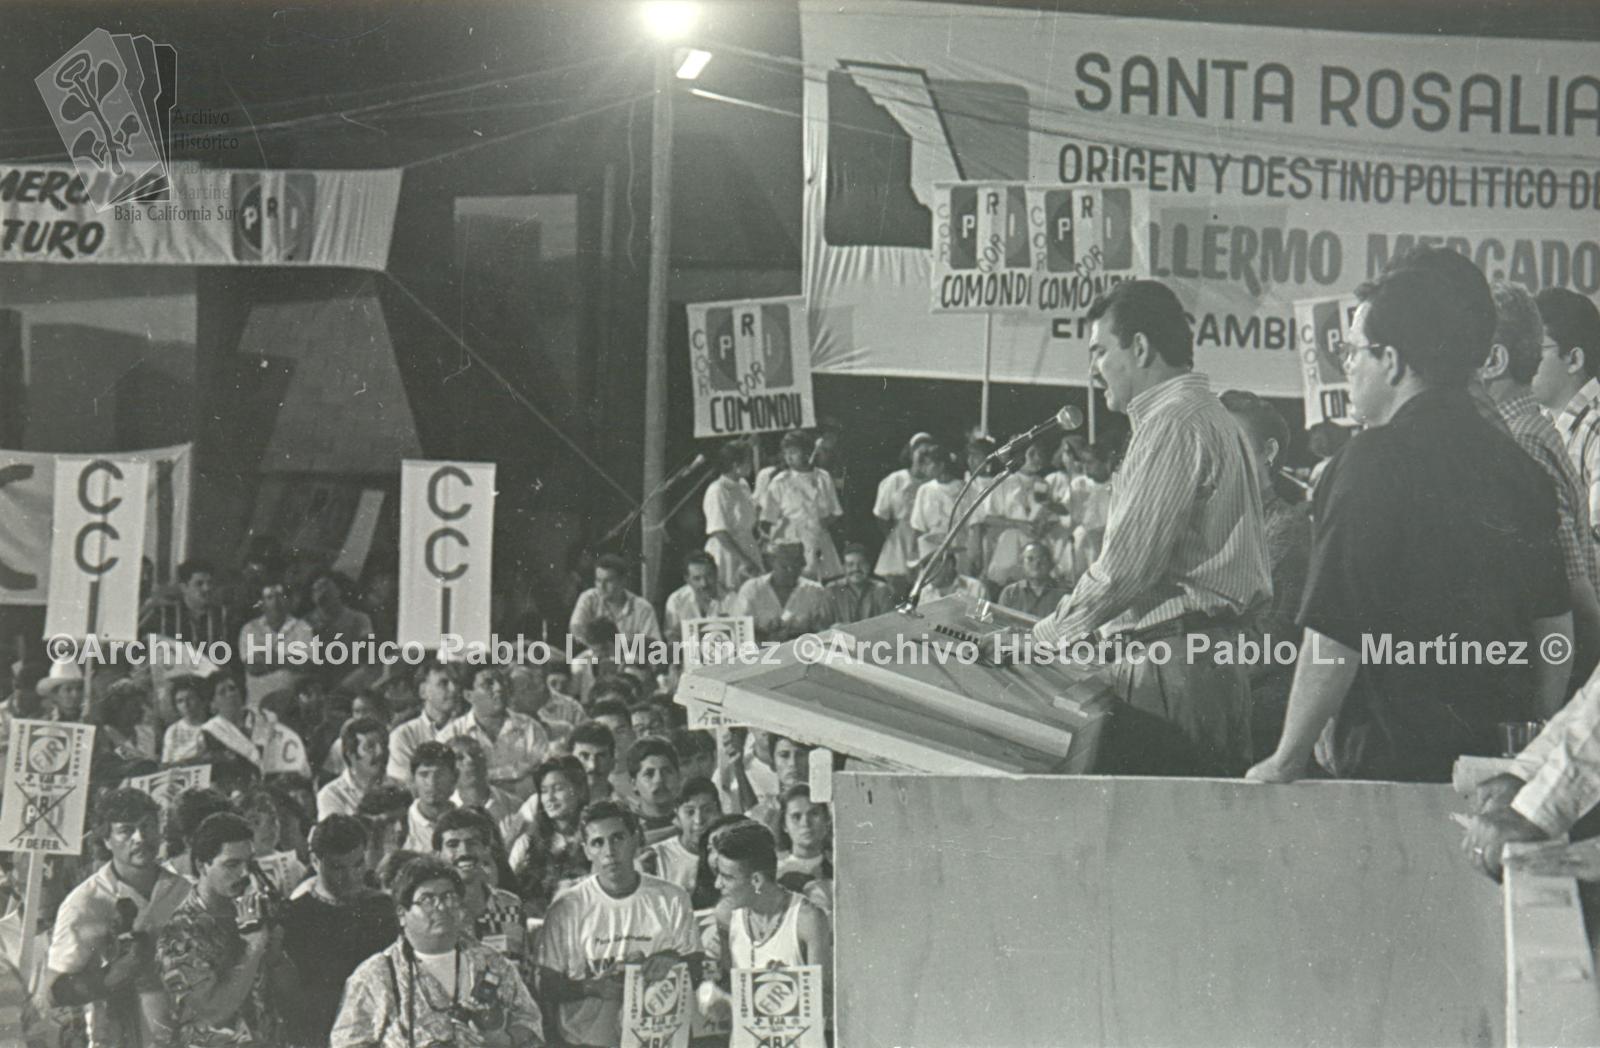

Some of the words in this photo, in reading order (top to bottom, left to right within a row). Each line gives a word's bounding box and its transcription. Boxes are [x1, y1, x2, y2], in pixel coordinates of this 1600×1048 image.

[1075, 53, 1294, 123] SANTA
[1320, 66, 1600, 136] ROSALIA
[1059, 143, 1196, 193] ORIGEN
[1209, 153, 1231, 194] Y
[1242, 155, 1395, 205] DESTINO
[1404, 164, 1557, 209] POLITICO
[1150, 222, 1342, 297] LLERMO
[1184, 312, 1297, 350] AMBI
[710, 393, 802, 433] COMONDU
